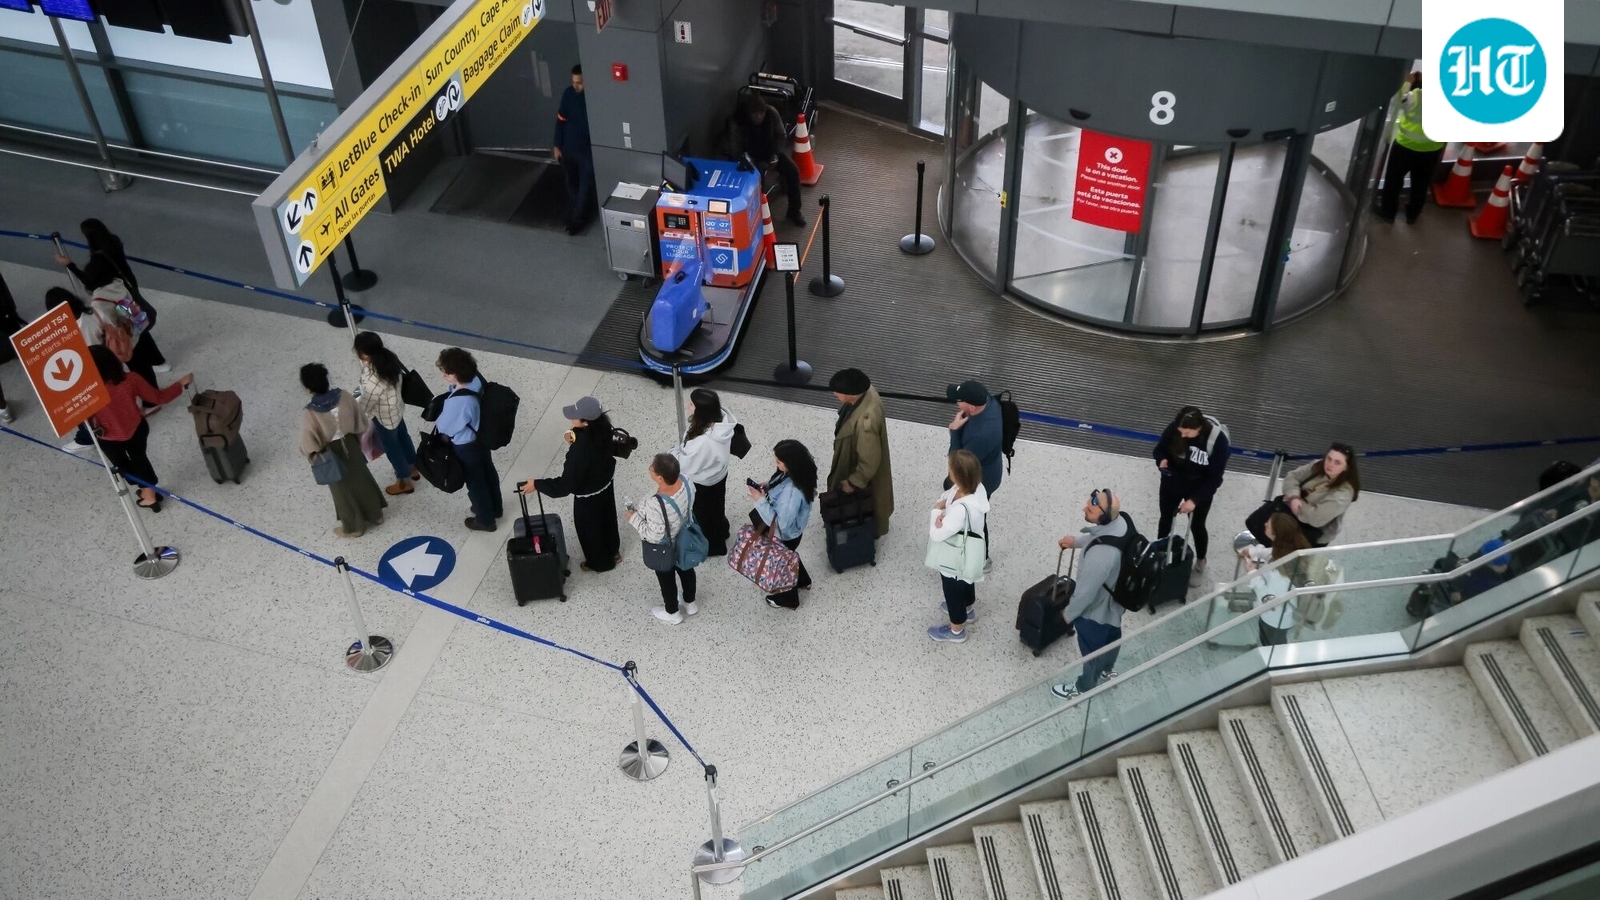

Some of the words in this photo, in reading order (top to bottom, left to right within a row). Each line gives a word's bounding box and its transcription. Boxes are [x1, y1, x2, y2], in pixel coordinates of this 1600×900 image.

[425, 61, 443, 85] Sun
[444, 25, 480, 66] Country,
[480, 1, 500, 27] Cape
[463, 40, 498, 83] Baggage
[499, 15, 521, 43] Claim
[1149, 91, 1176, 125] 8
[338, 131, 377, 178] JetBlue
[378, 84, 422, 134] Check-in
[385, 145, 410, 173] TWA
[410, 110, 435, 148] Hotel
[1080, 173, 1097, 182] Please
[1106, 180, 1127, 188] another
[1096, 162, 1110, 171] This
[1107, 172, 1138, 183] vacation.
[335, 197, 349, 224] All
[351, 168, 380, 204] Gates
[1090, 186, 1105, 195] Esta
[1105, 190, 1129, 199] puerta
[1101, 196, 1141, 208] vacaciones.
[337, 217, 351, 235] Todas
[351, 211, 359, 220] las
[359, 193, 376, 214] puertas
[665, 243, 693, 251] PROTECT
[20, 323, 51, 347] General
[51, 312, 69, 327] TSA
[29, 325, 68, 353] screening
[26, 355, 40, 366] line
[41, 342, 62, 357] starts
[62, 329, 79, 340] here
[71, 381, 98, 402] seguridad
[80, 393, 92, 403] TSA
